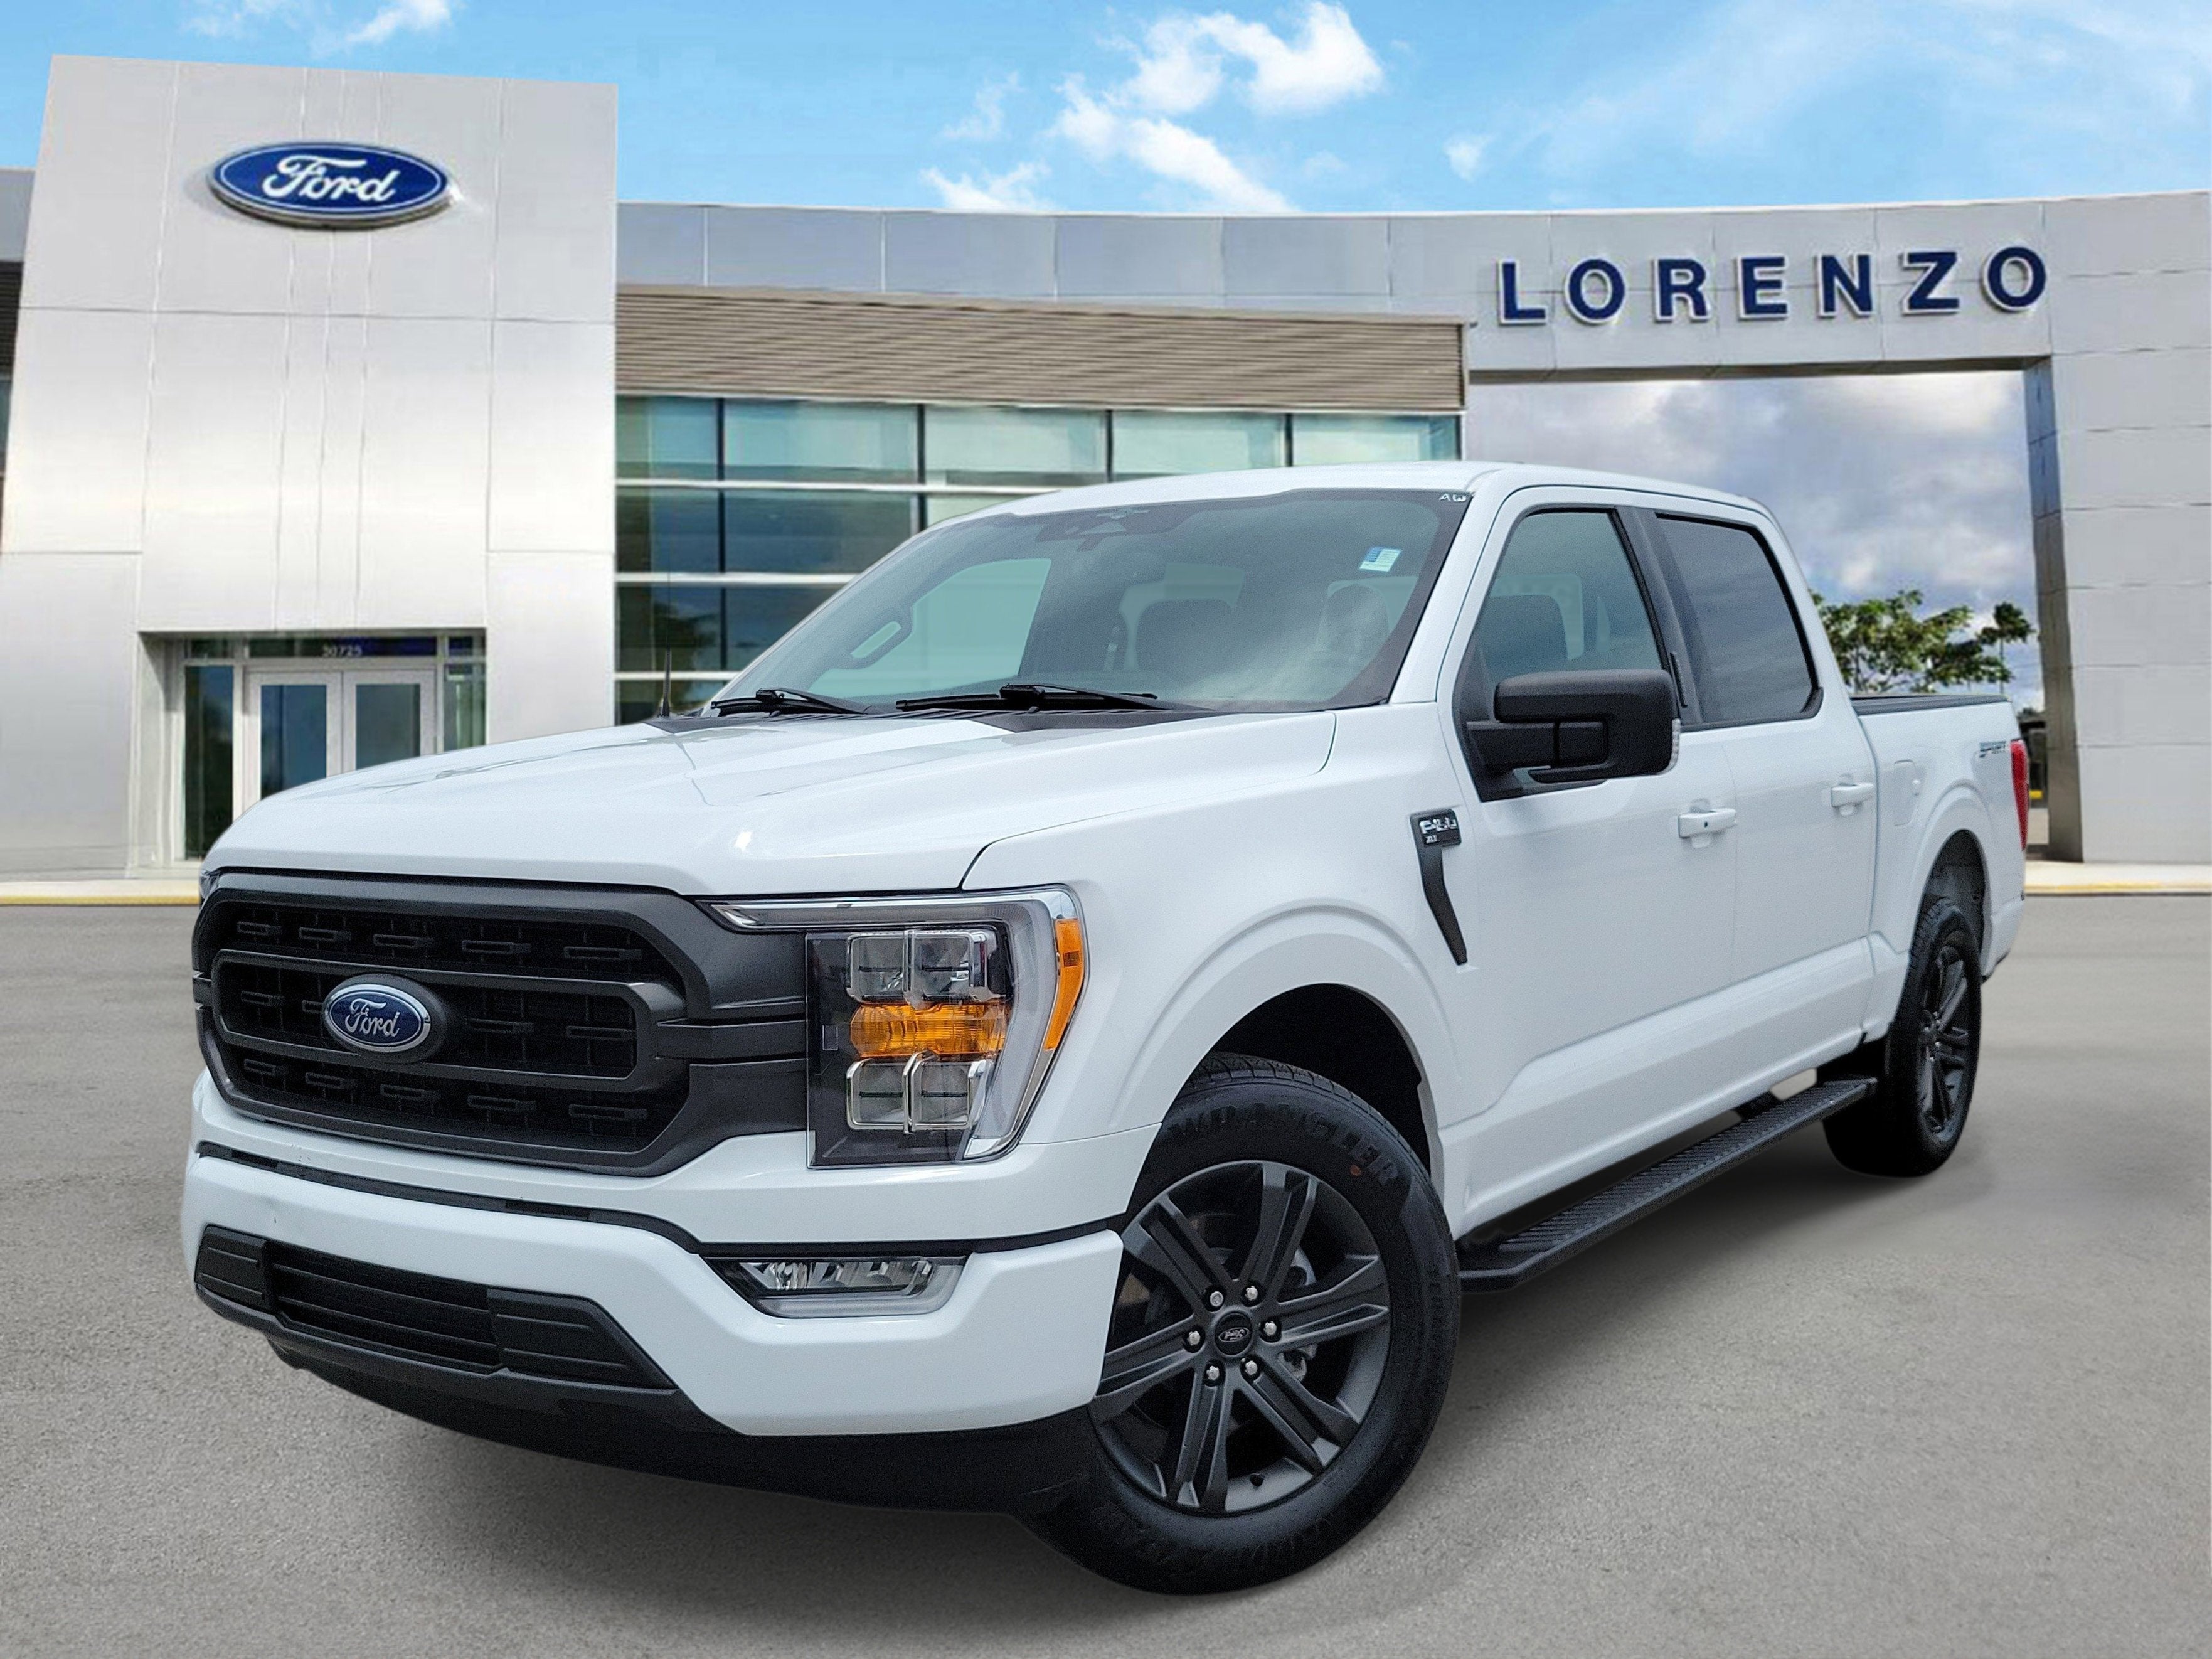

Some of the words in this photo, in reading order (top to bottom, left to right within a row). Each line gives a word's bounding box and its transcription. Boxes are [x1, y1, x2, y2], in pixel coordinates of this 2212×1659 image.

[262, 154, 401, 202] Ford
[1498, 247, 2047, 325] LORENZO
[344, 998, 401, 1038] Ford
